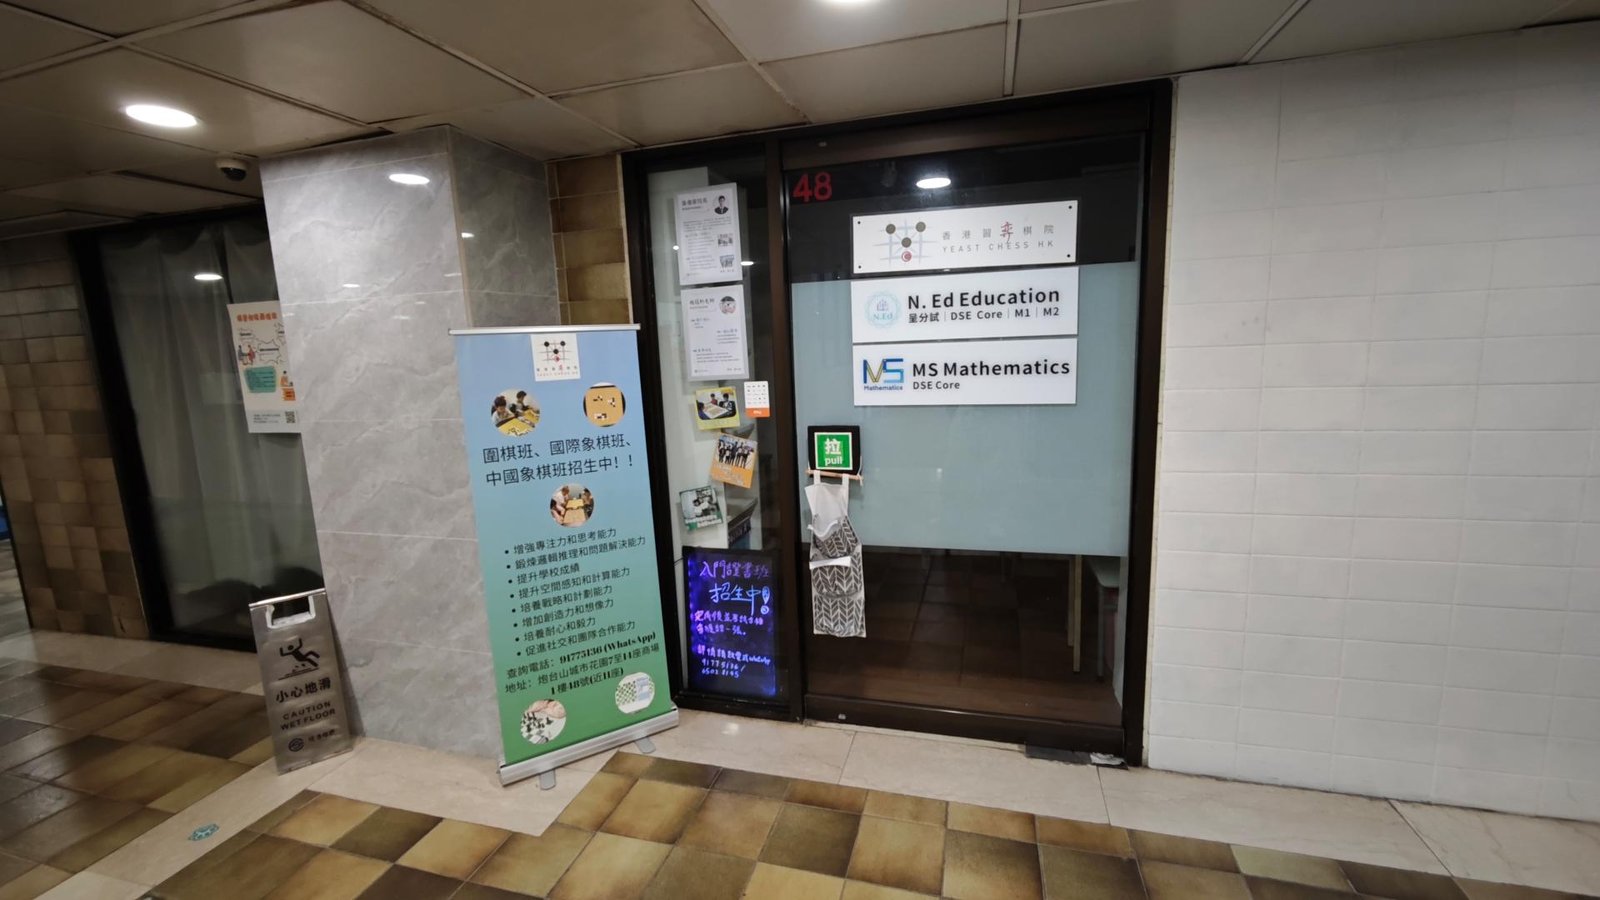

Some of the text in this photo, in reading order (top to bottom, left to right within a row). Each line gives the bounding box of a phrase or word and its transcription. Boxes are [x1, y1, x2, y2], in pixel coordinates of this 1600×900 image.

[792, 171, 832, 202] 48
[943, 244, 979, 253] YEAST
[988, 242, 1029, 250] CHESS
[908, 288, 1060, 309] N. Ed Education
[908, 307, 1060, 324] 呈分試 DSE Core M1 M2
[912, 359, 1070, 377] MS Mathematics
[912, 380, 960, 390] DSE Core
[824, 438, 842, 455] 拉
[825, 456, 843, 466] pull
[517, 563, 580, 584] 提升學校成績
[604, 632, 656, 653] (WhatsApp)
[276, 677, 331, 703] 小心地滑
[281, 708, 336, 730] WET FLOOR
[282, 701, 331, 720] CAUTION
